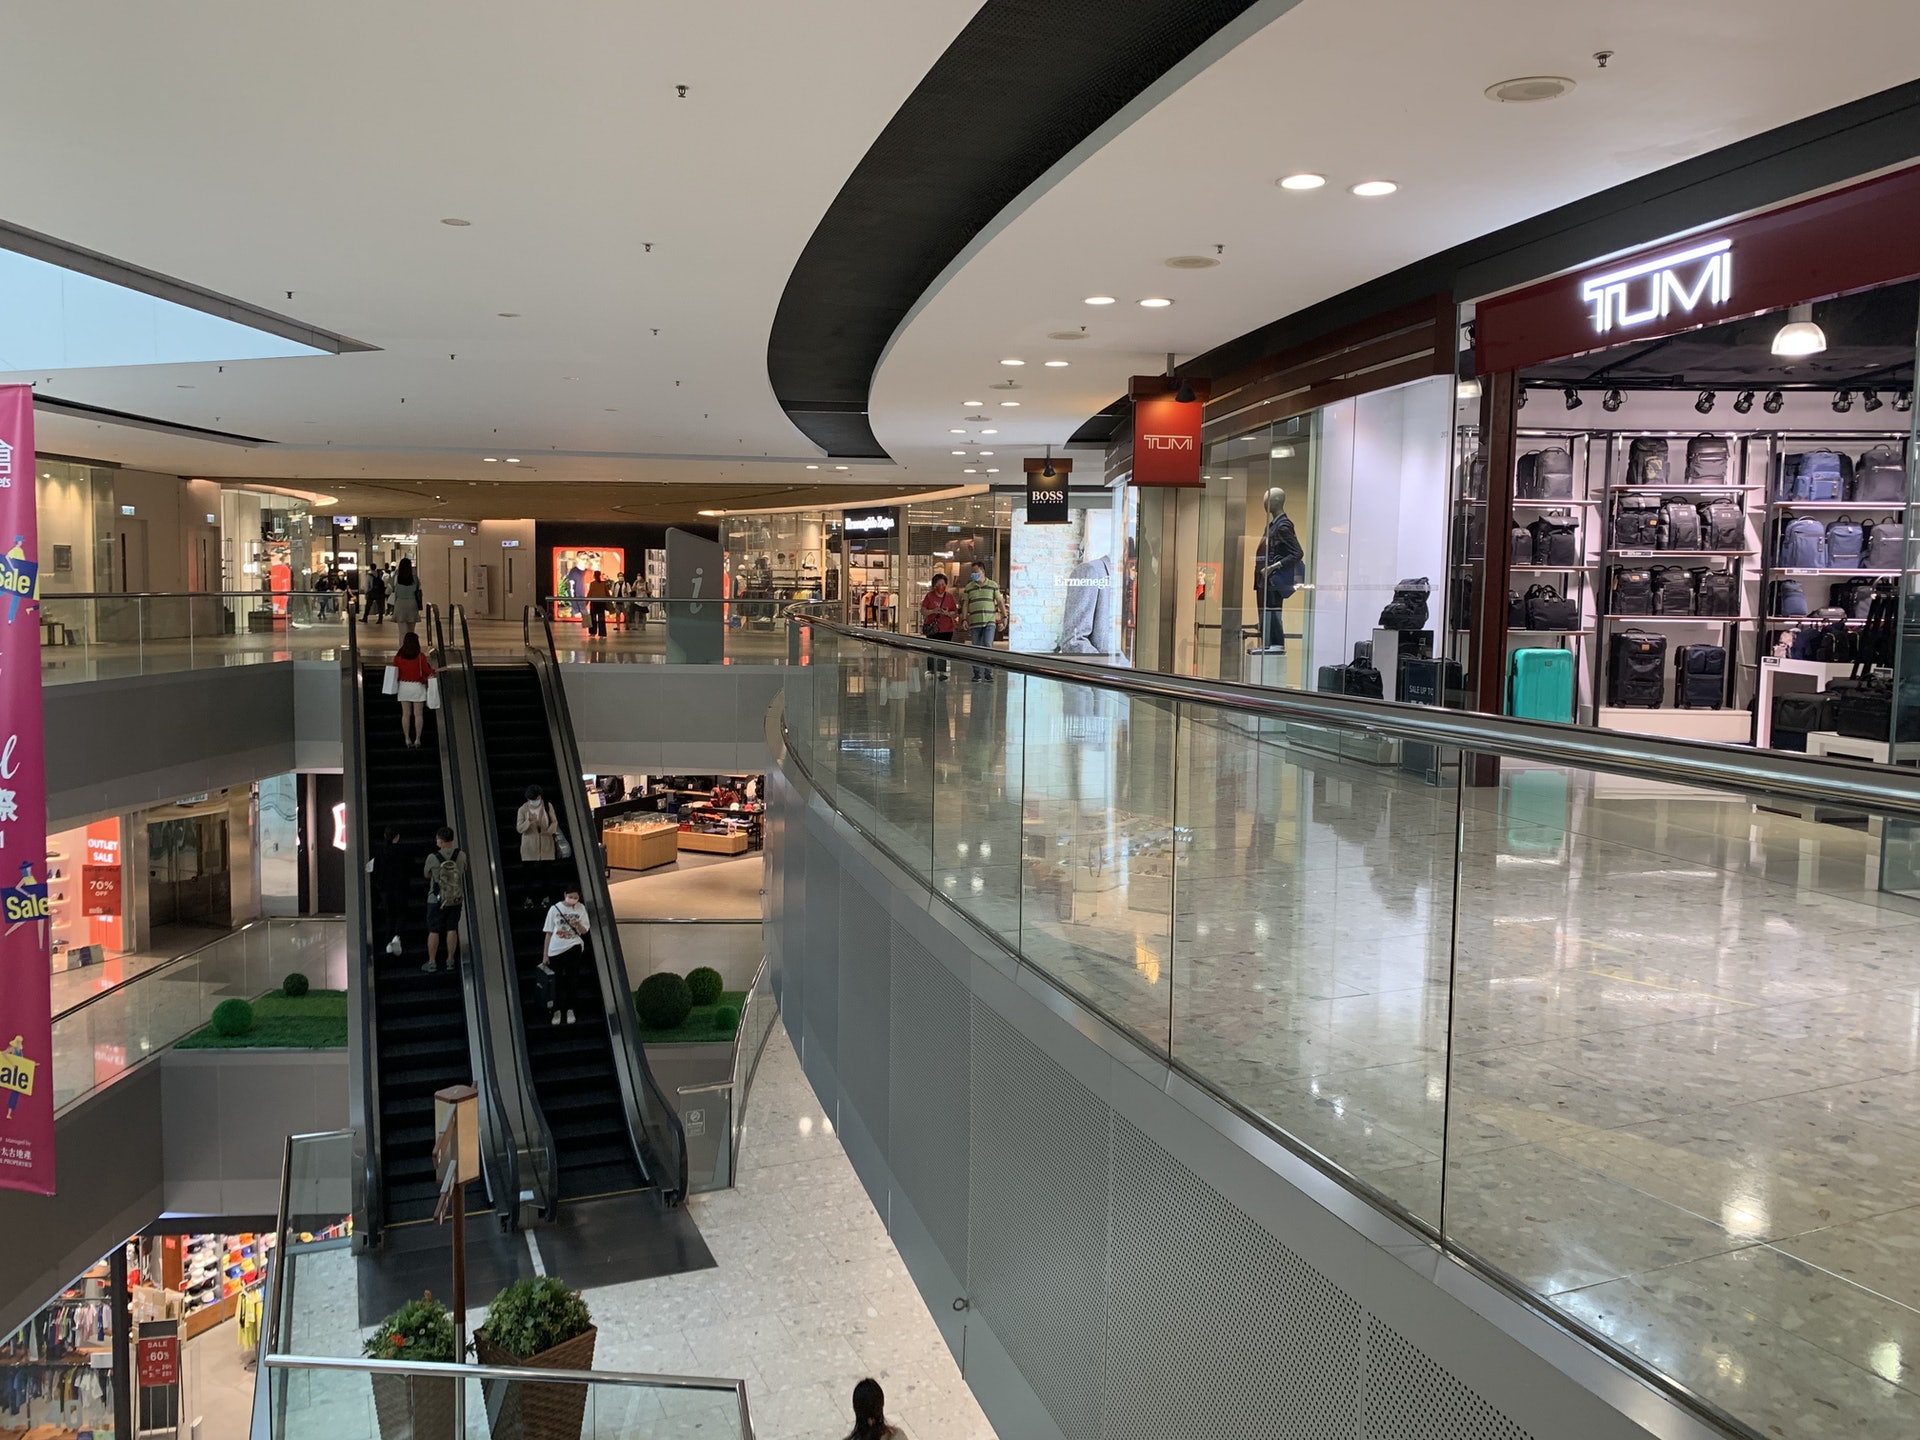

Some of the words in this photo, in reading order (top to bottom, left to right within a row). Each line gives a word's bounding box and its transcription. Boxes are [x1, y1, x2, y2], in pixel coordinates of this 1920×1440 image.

[1583, 238, 1732, 332] TUMI
[1143, 434, 1193, 450] TUMI
[1032, 490, 1064, 501] BOSS
[88, 838, 119, 851] OUTLET
[93, 851, 114, 864] SALE
[89, 880, 114, 891] 70%
[6, 894, 49, 920] Sale
